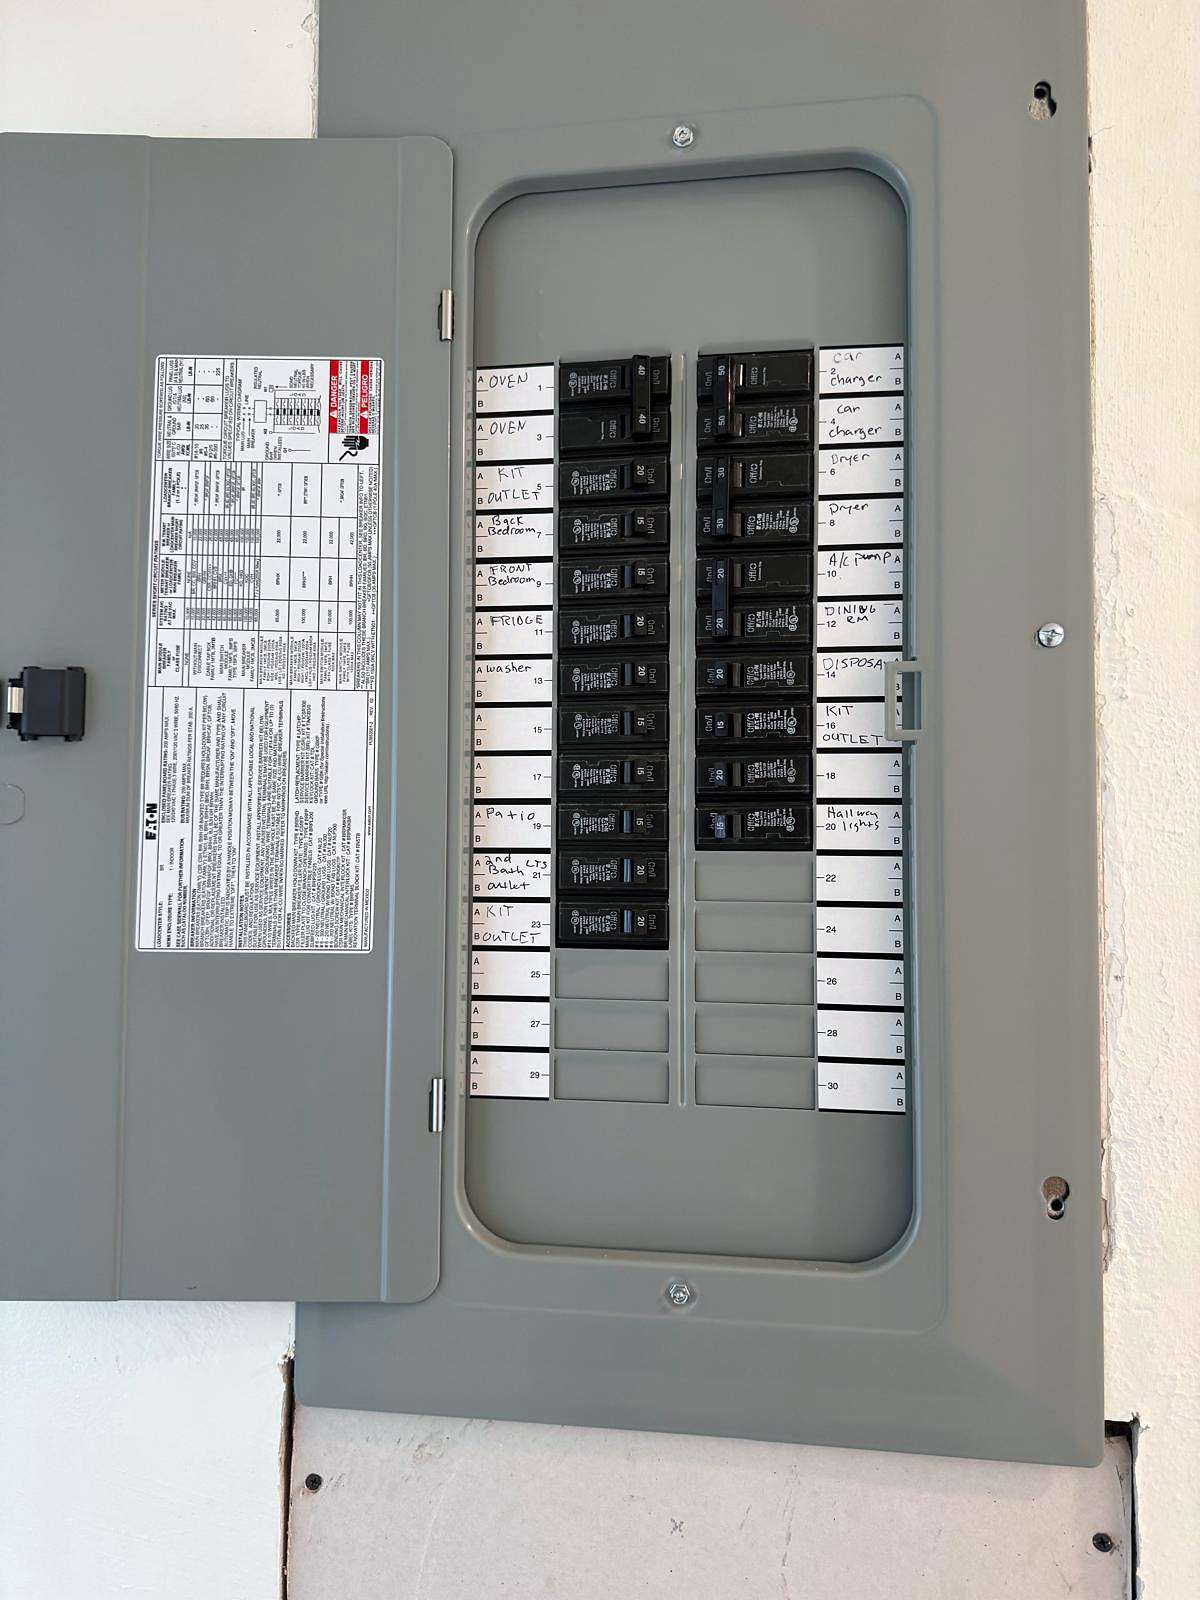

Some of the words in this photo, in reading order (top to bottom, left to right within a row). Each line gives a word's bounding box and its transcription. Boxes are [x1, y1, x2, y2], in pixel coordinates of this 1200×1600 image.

[638, 365, 645, 375] 40
[718, 366, 725, 375] 50
[489, 372, 528, 388] OVEN
[831, 374, 882, 386] charger
[639, 414, 646, 424] 40
[718, 416, 725, 425] 50
[490, 420, 526, 435] OVEN
[829, 426, 882, 439] charger
[832, 454, 870, 465] Dryer
[498, 467, 525, 481] KIT
[637, 466, 644, 475] 20
[718, 467, 724, 477] 30
[488, 489, 541, 504] OUTLET
[829, 503, 868, 515] Dryer
[717, 519, 723, 528] 30
[488, 525, 535, 535] Bedroom
[829, 552, 848, 568] A/C
[488, 563, 532, 575] FRONT
[718, 568, 724, 578] 20
[488, 575, 535, 586] Bedroom
[490, 615, 542, 626] FRIDGE
[637, 617, 644, 626] 20
[716, 618, 723, 628] 20
[487, 663, 531, 673] washer
[823, 657, 887, 671] DISPOSA
[639, 666, 645, 676] 20
[716, 669, 723, 679] 20
[826, 706, 853, 716] KIT
[823, 733, 885, 745] OUTLET
[716, 770, 723, 780] 20
[486, 808, 535, 821] Patio
[828, 807, 878, 819] Hallway
[843, 819, 879, 832] lights
[526, 860, 547, 869] LTS
[637, 865, 644, 875] 20
[826, 874, 836, 882] 22
[487, 905, 513, 918] KIT
[638, 917, 644, 926] 20
[474, 957, 479, 965] A
